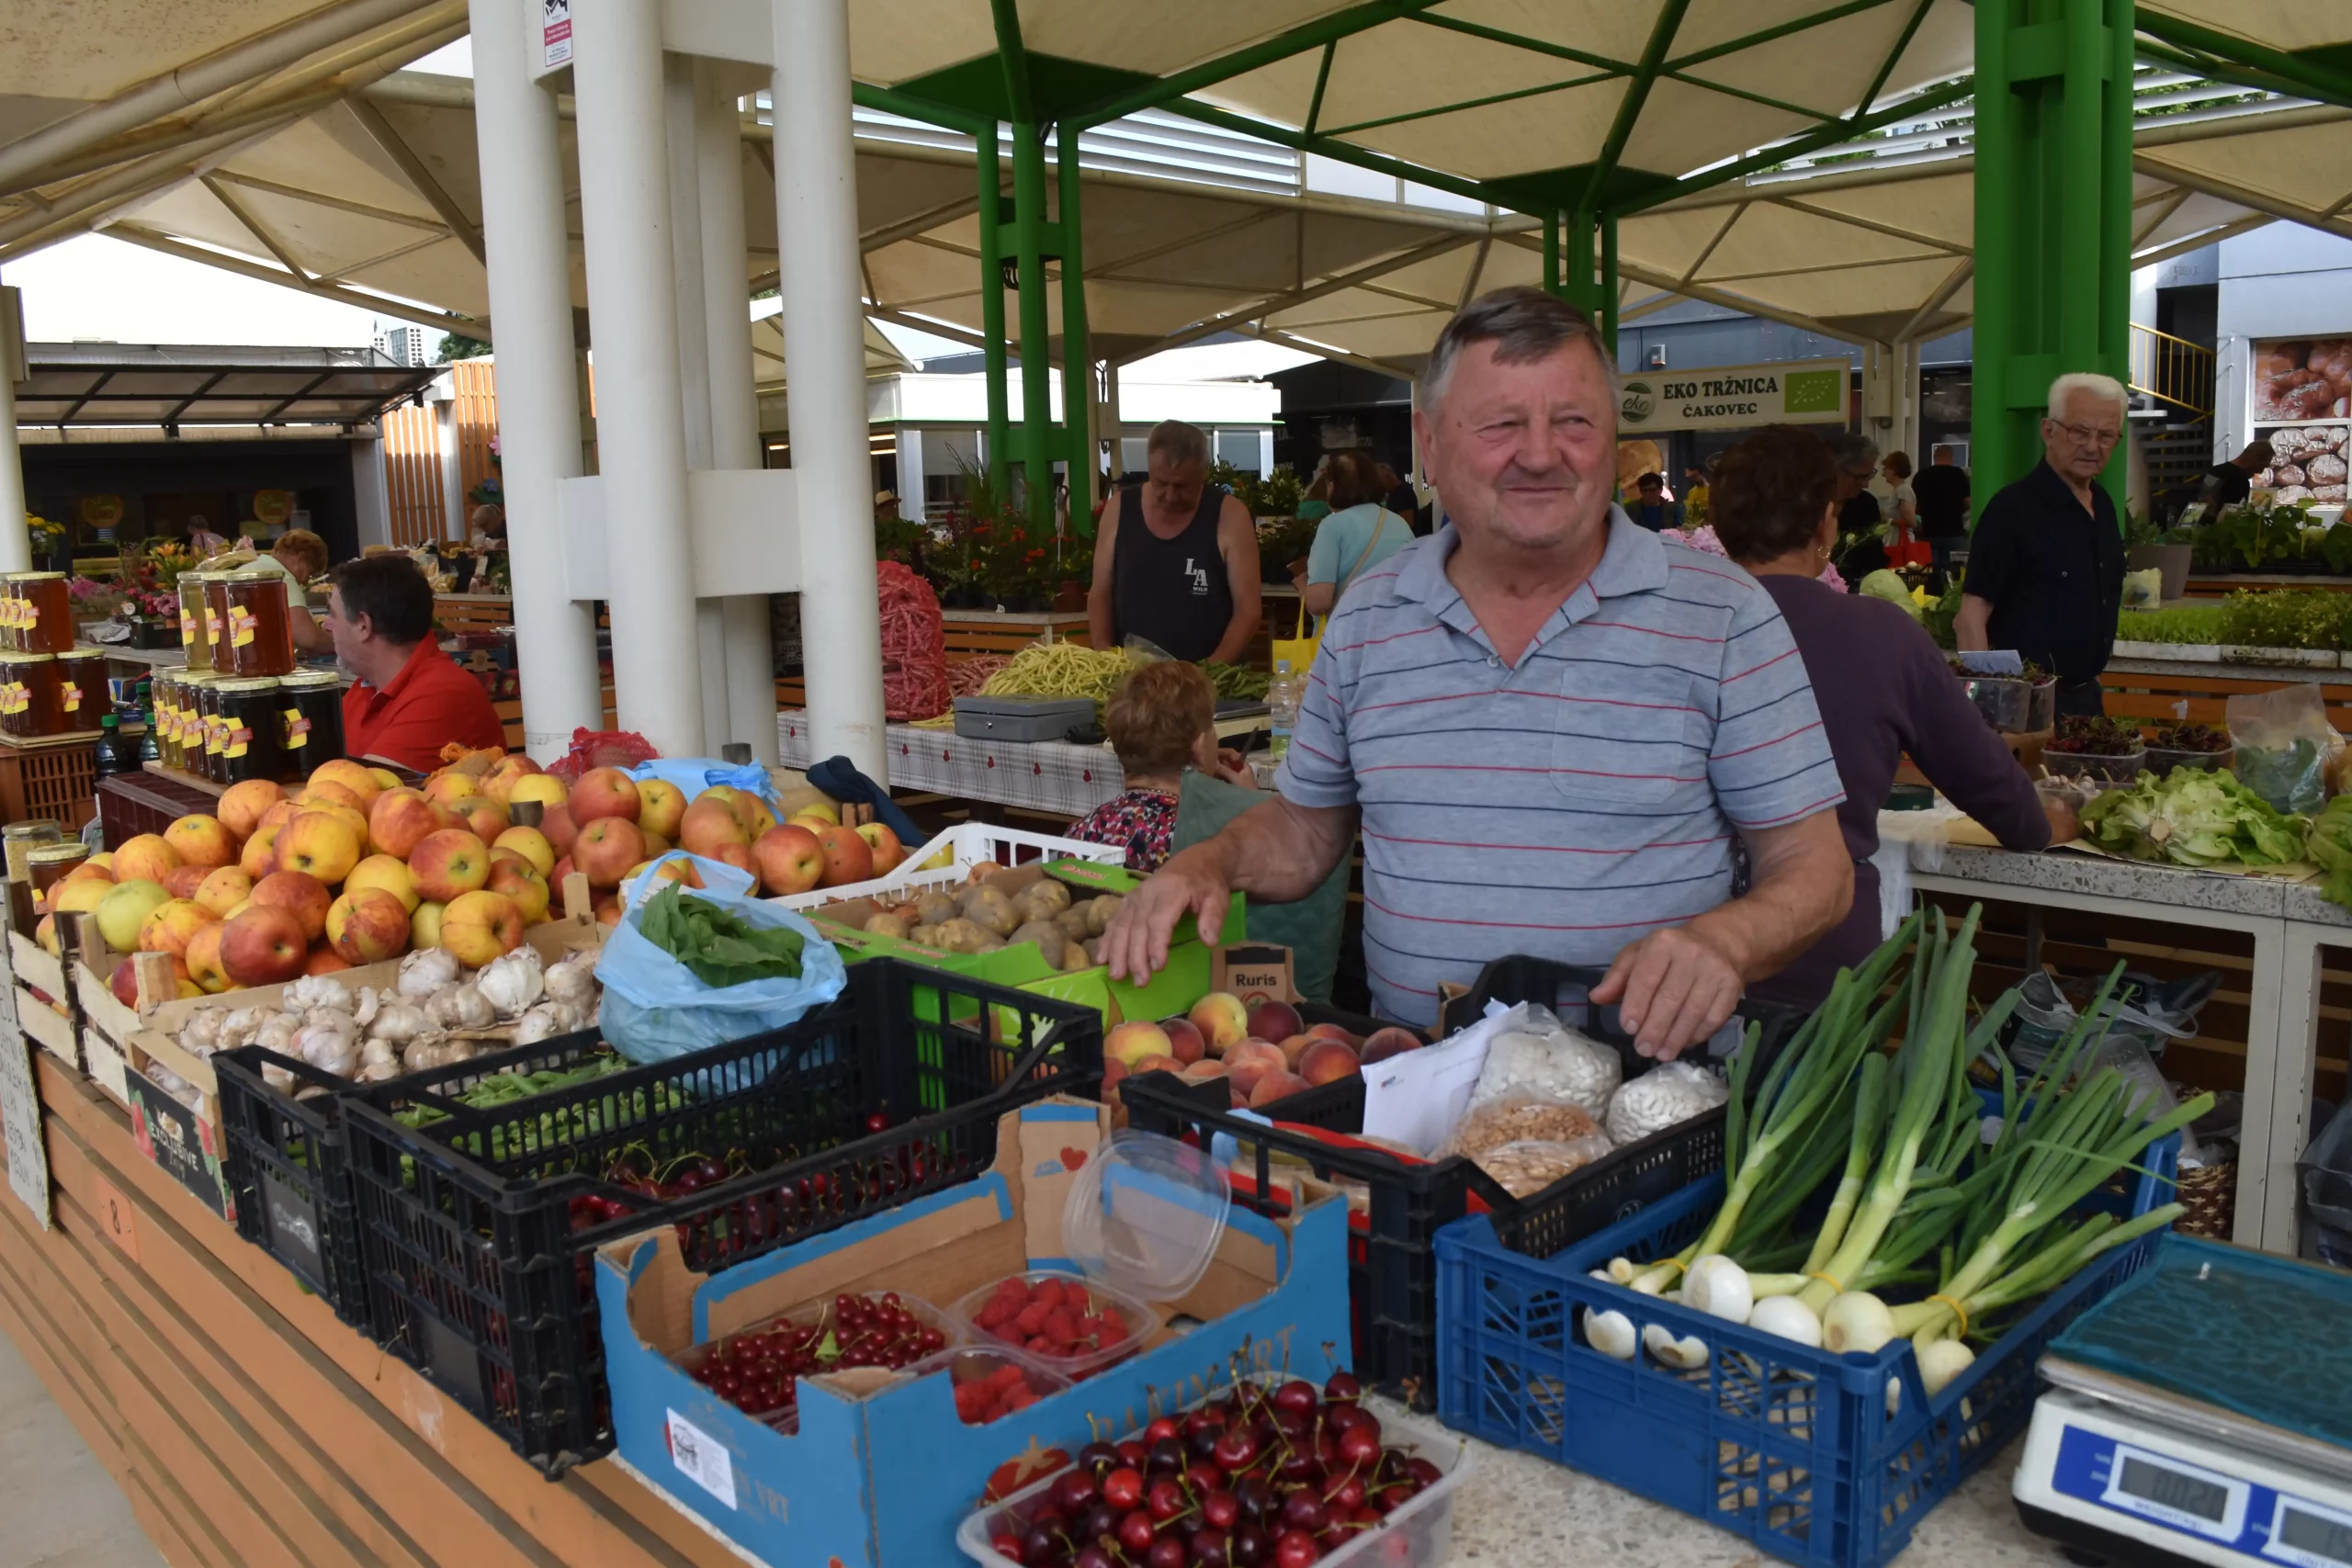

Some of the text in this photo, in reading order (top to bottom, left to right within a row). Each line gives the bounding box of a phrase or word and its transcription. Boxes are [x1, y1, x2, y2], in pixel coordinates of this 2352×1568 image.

[1663, 375, 1778, 400] EKO TRŽNICA
[1622, 393, 1650, 412] eko
[1682, 402, 1757, 417] ČAKOVEC
[1236, 973, 1277, 987] Ruris
[149, 1122, 198, 1171] EXCLUSIVE
[109, 1198, 121, 1235] 8
